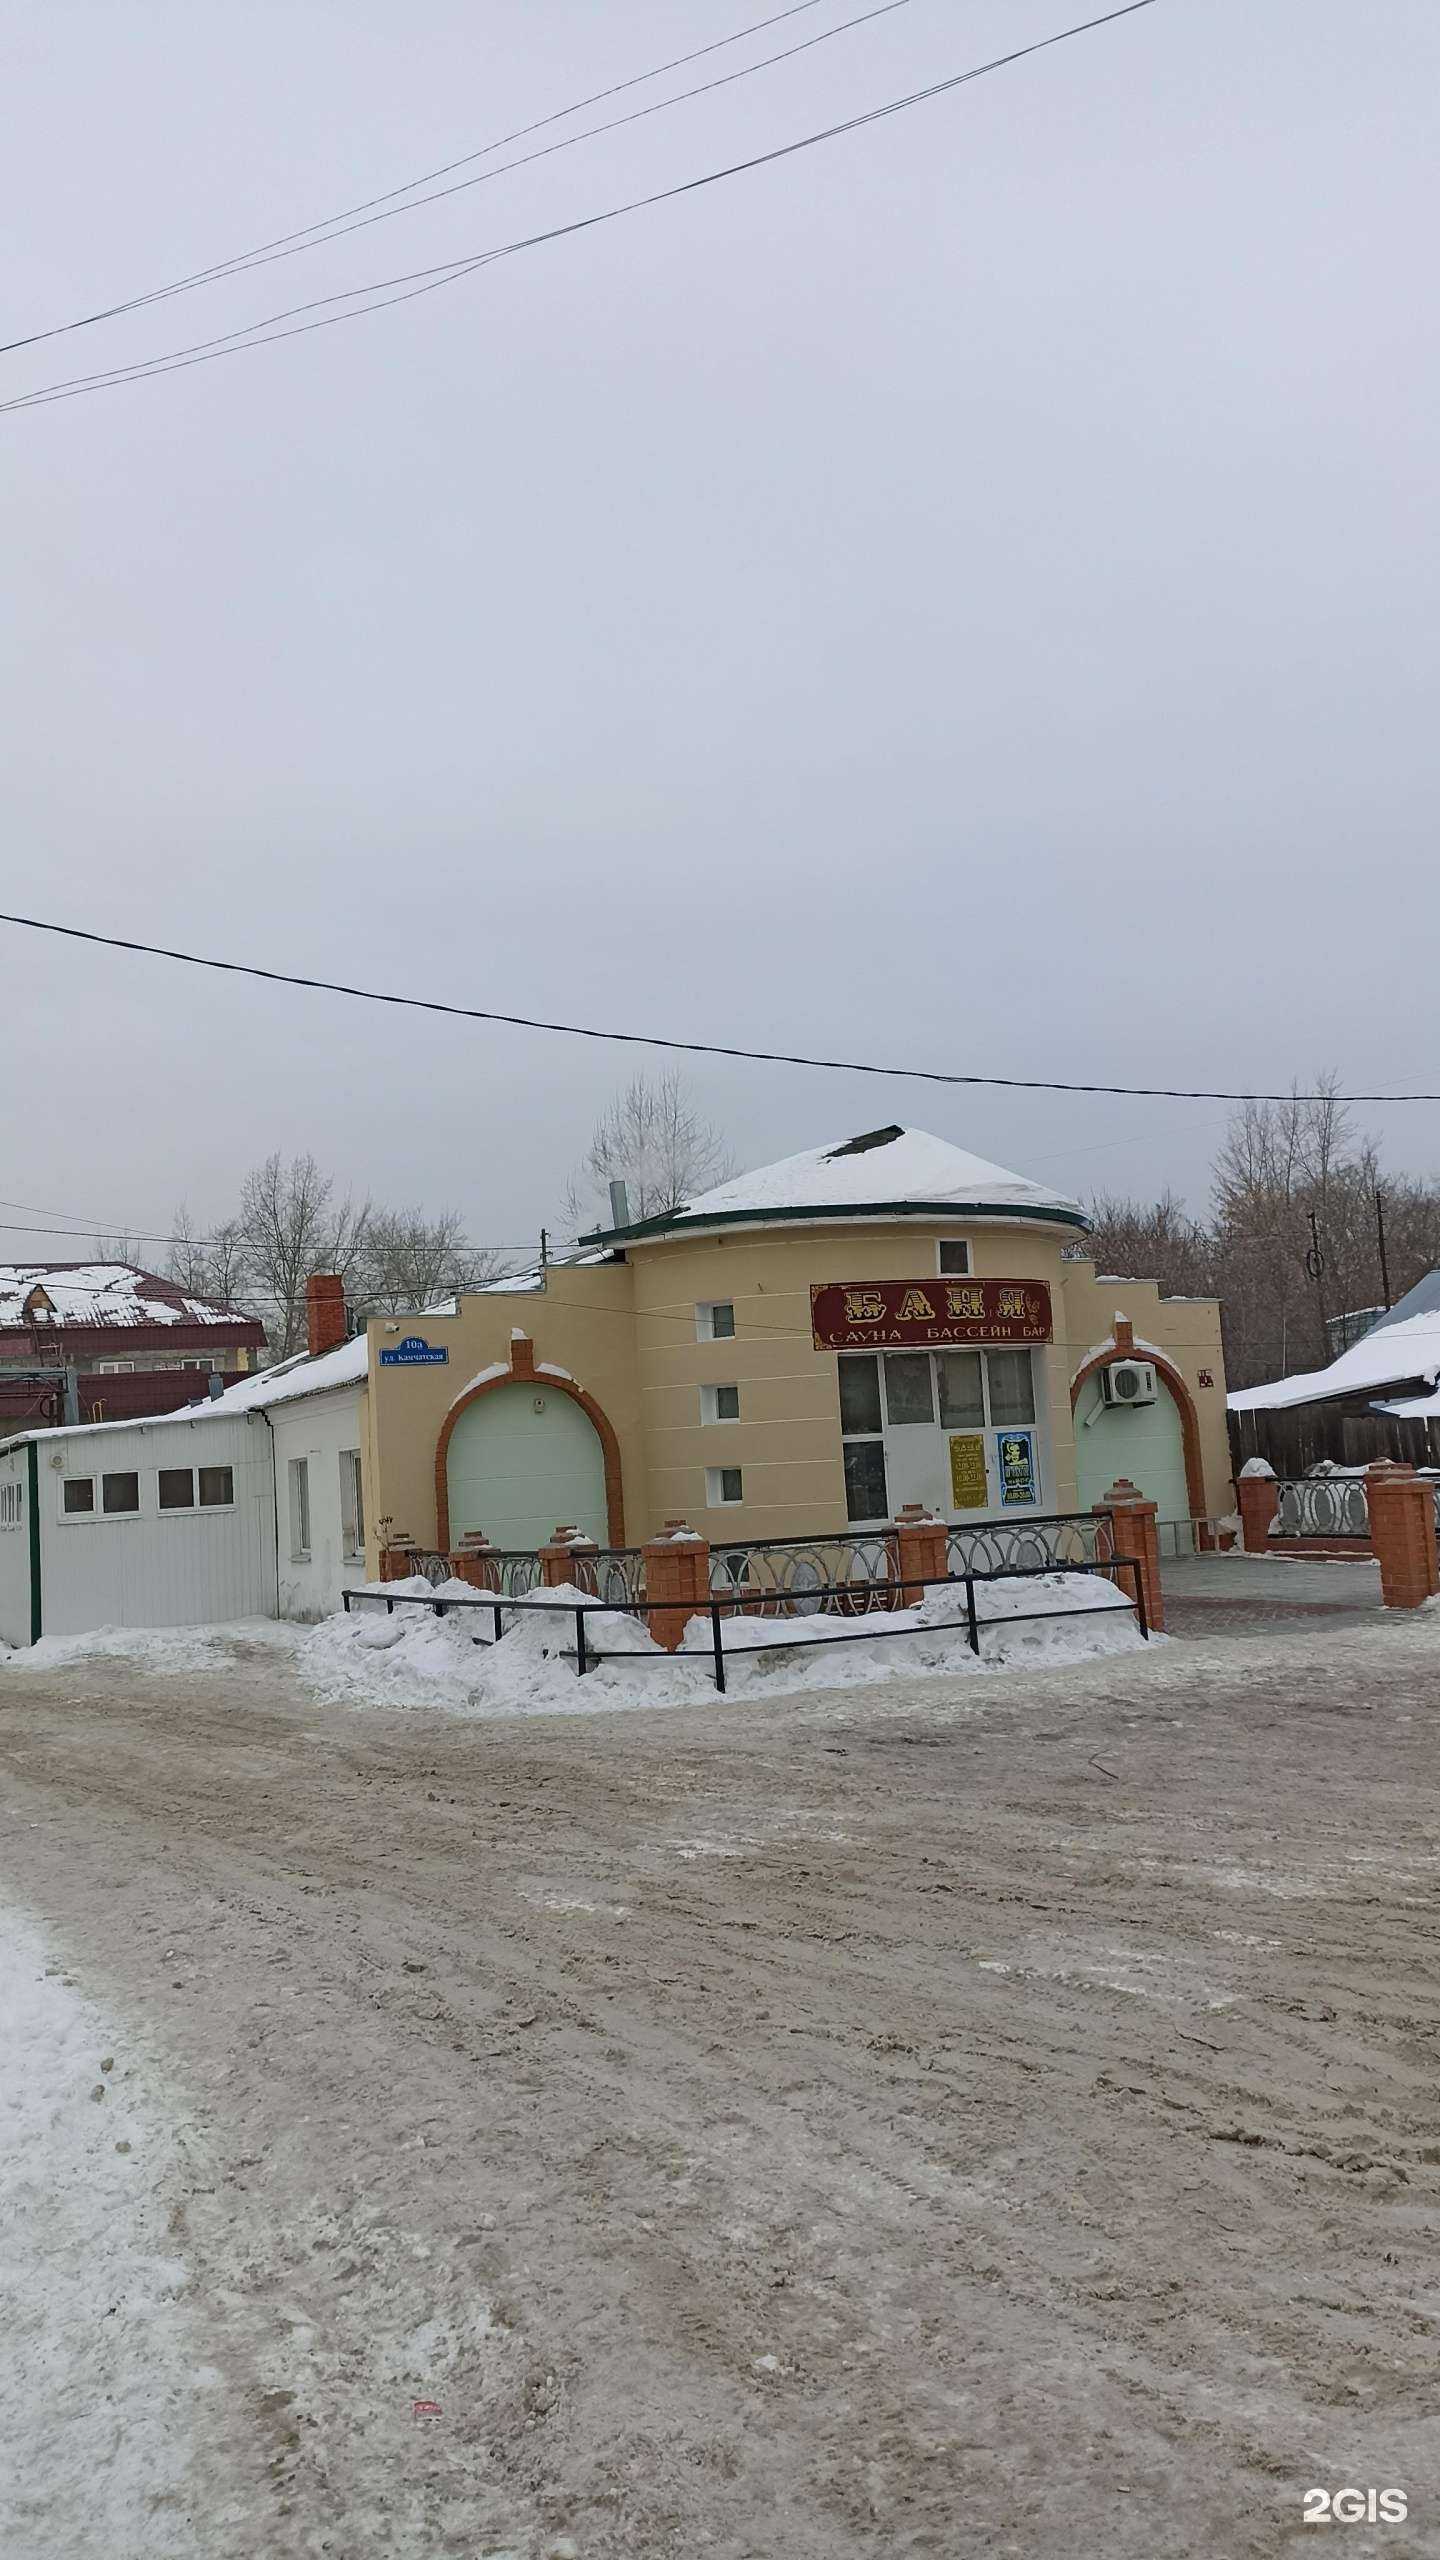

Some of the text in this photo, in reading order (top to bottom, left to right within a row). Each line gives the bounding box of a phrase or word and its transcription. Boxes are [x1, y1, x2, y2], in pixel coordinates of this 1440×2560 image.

[845, 1287, 1026, 1324] БАНЯ
[829, 1325, 1046, 1343] САУНА БАССЕЙН БАР
